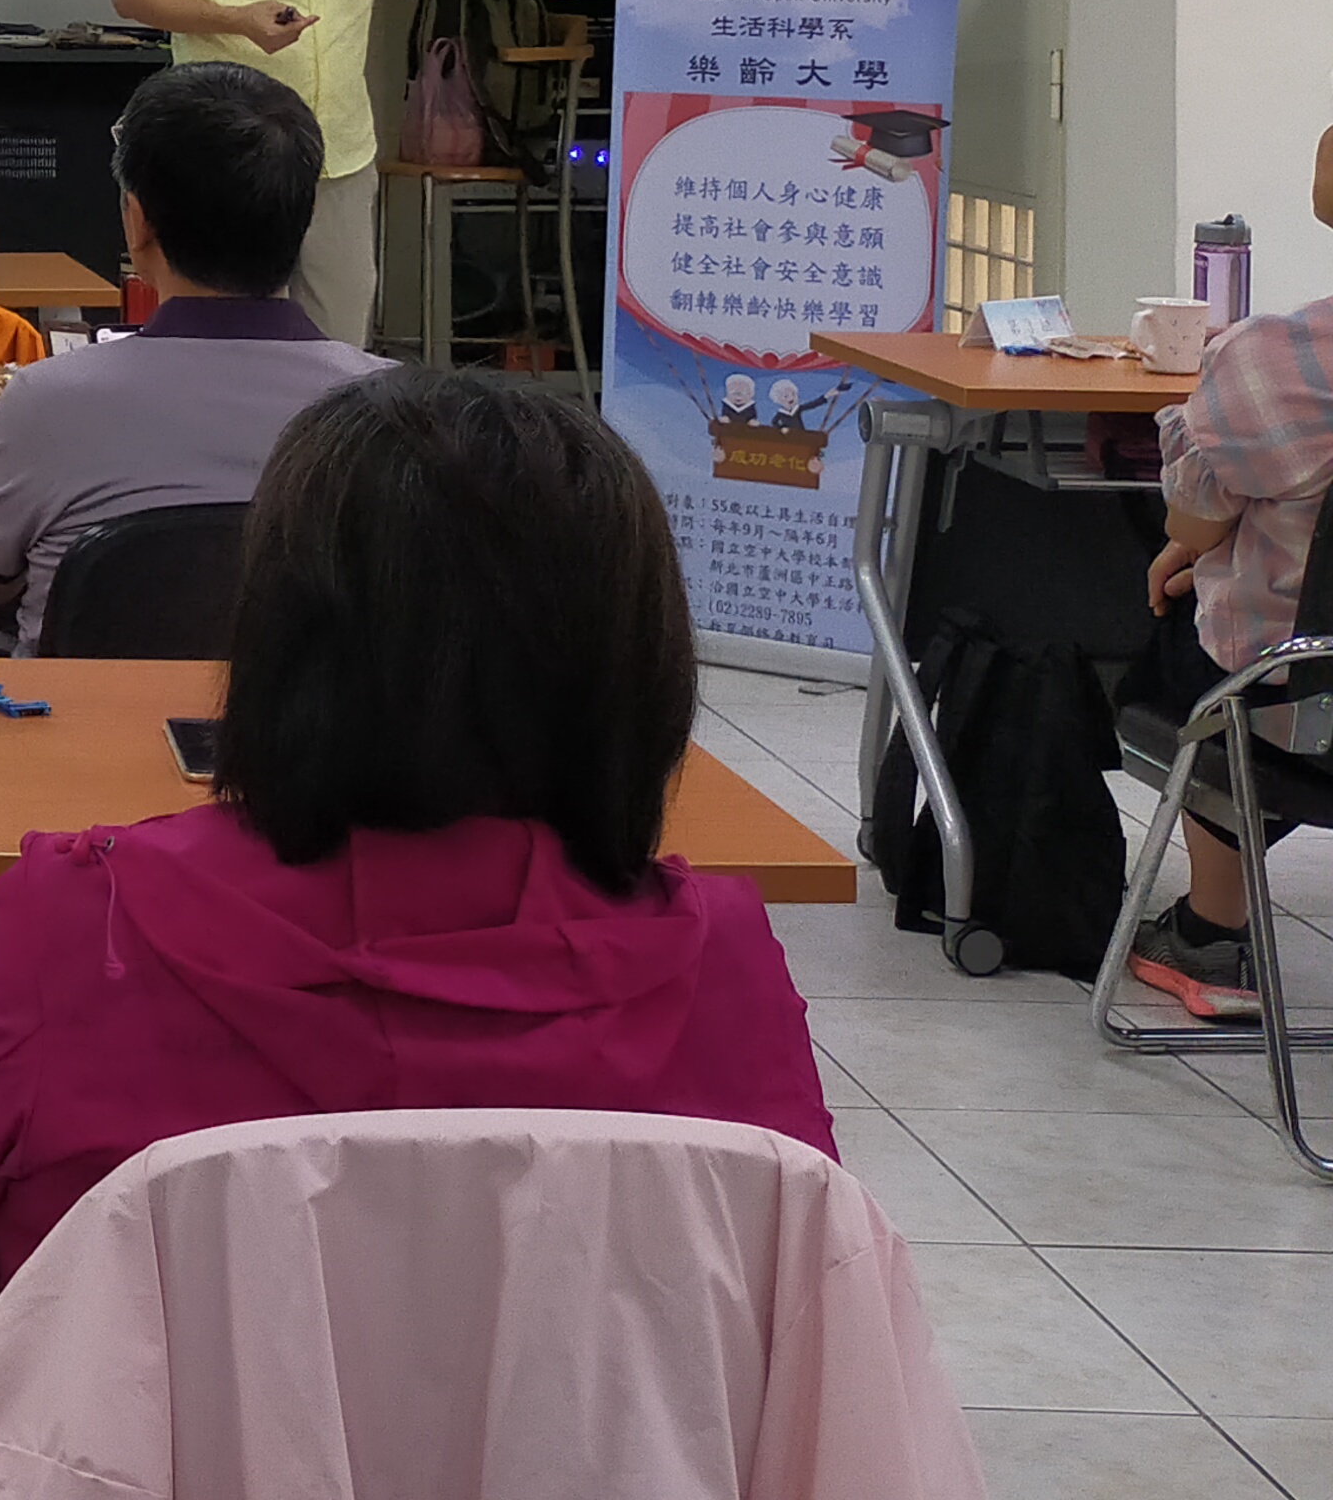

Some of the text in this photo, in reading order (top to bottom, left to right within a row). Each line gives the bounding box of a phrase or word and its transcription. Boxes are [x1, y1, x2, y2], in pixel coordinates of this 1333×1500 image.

[711, 16, 855, 41] 生活科學系
[686, 55, 889, 90] 樂齡大學
[674, 175, 885, 212] 維持個人身心健康
[671, 212, 885, 250] 提高社會參與意願
[671, 251, 883, 290] 健全社會安全意識
[669, 288, 879, 328] 翻轉樂齡快樂學習
[729, 449, 806, 471] 成功老化
